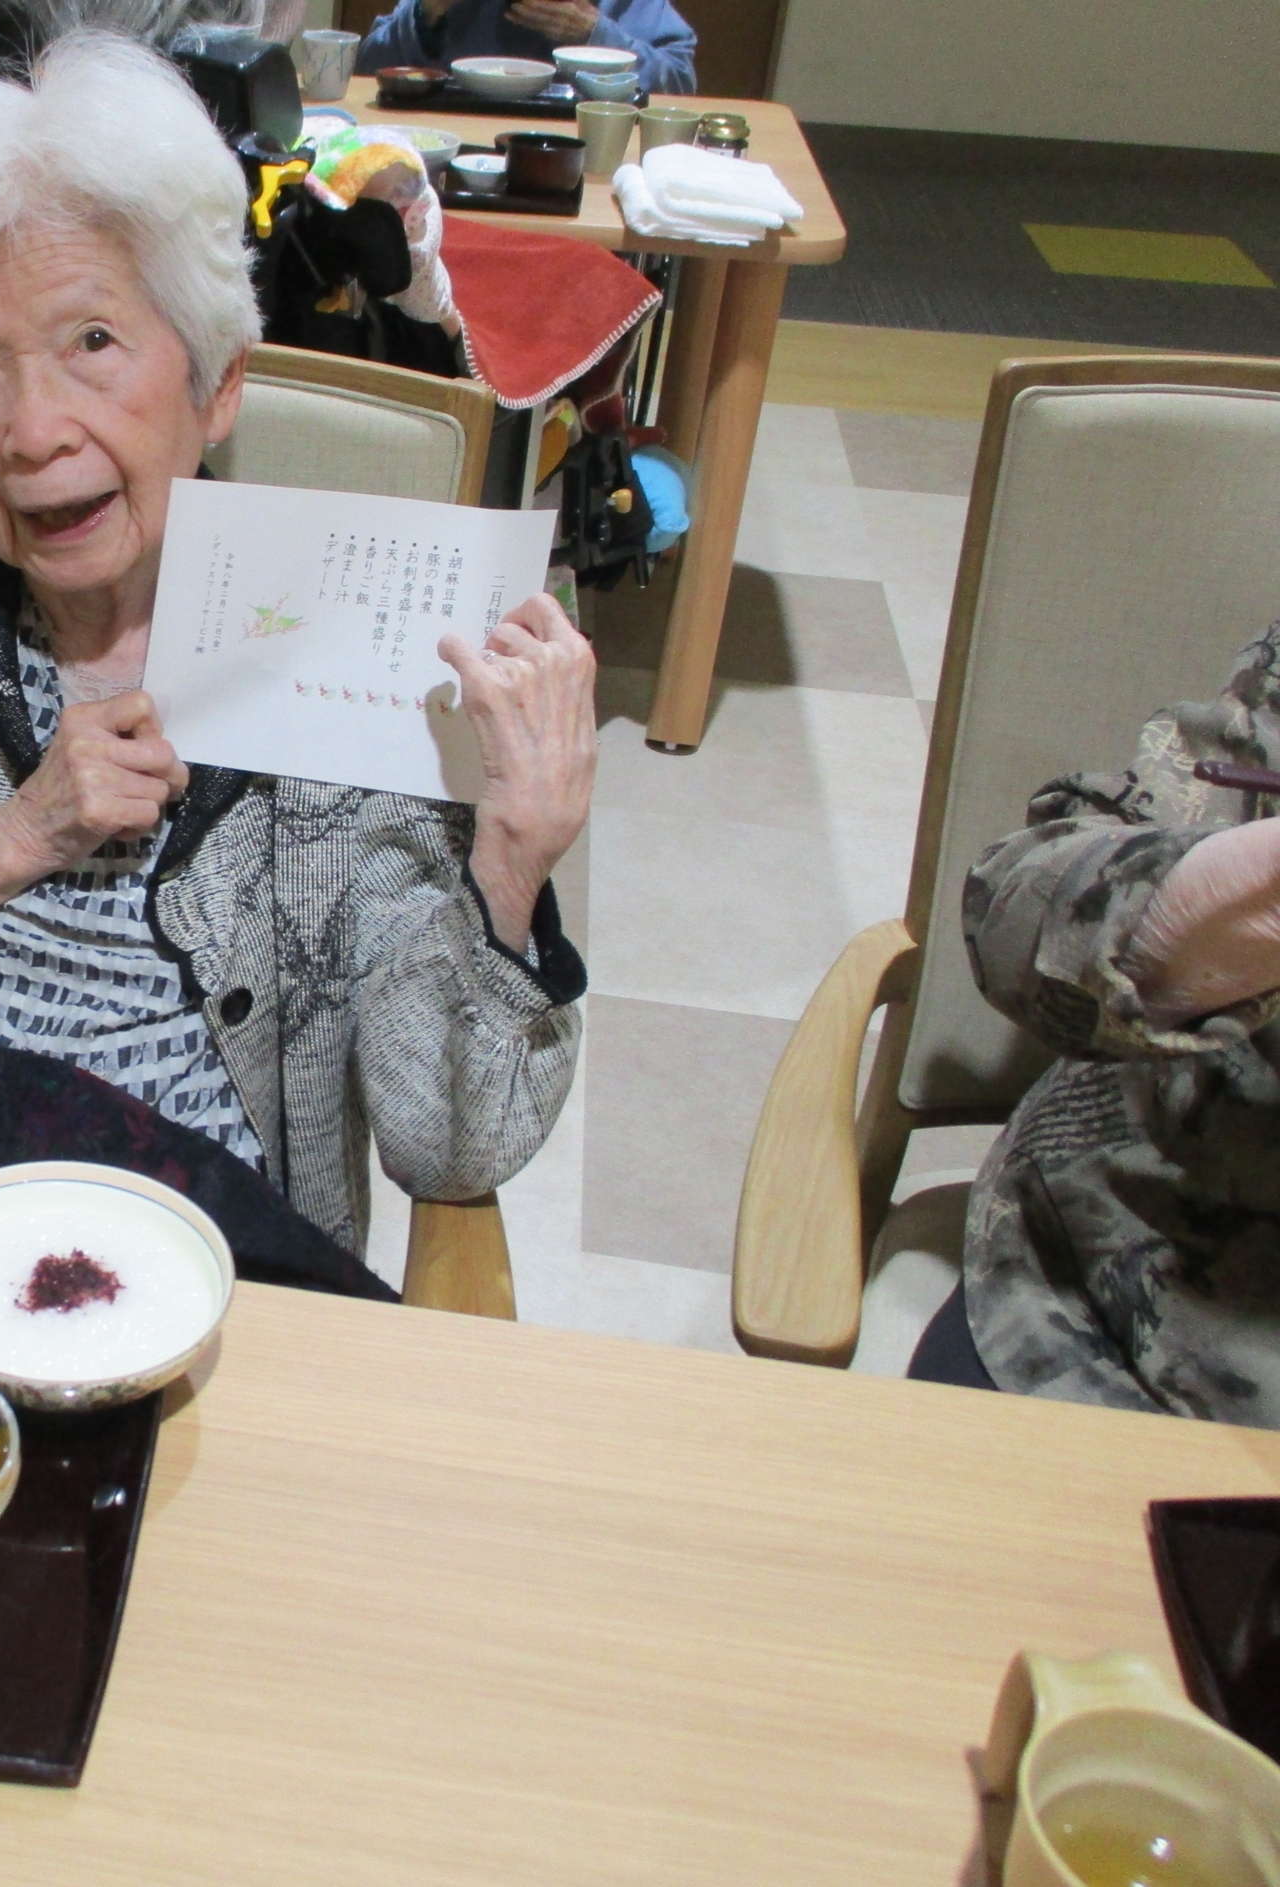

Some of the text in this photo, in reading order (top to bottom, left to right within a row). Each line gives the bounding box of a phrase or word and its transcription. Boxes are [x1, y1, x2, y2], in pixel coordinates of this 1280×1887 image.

[318, 541, 338, 600] デザート
[335, 543, 358, 603] 澄まし汁
[356, 545, 377, 606] 香りご飯
[419, 553, 441, 614] 豚の角煮
[440, 556, 463, 618] 胡麻豆腐
[371, 548, 398, 656] 天ぷら三種盛り
[388, 550, 419, 673] お刺身盛り合わせ
